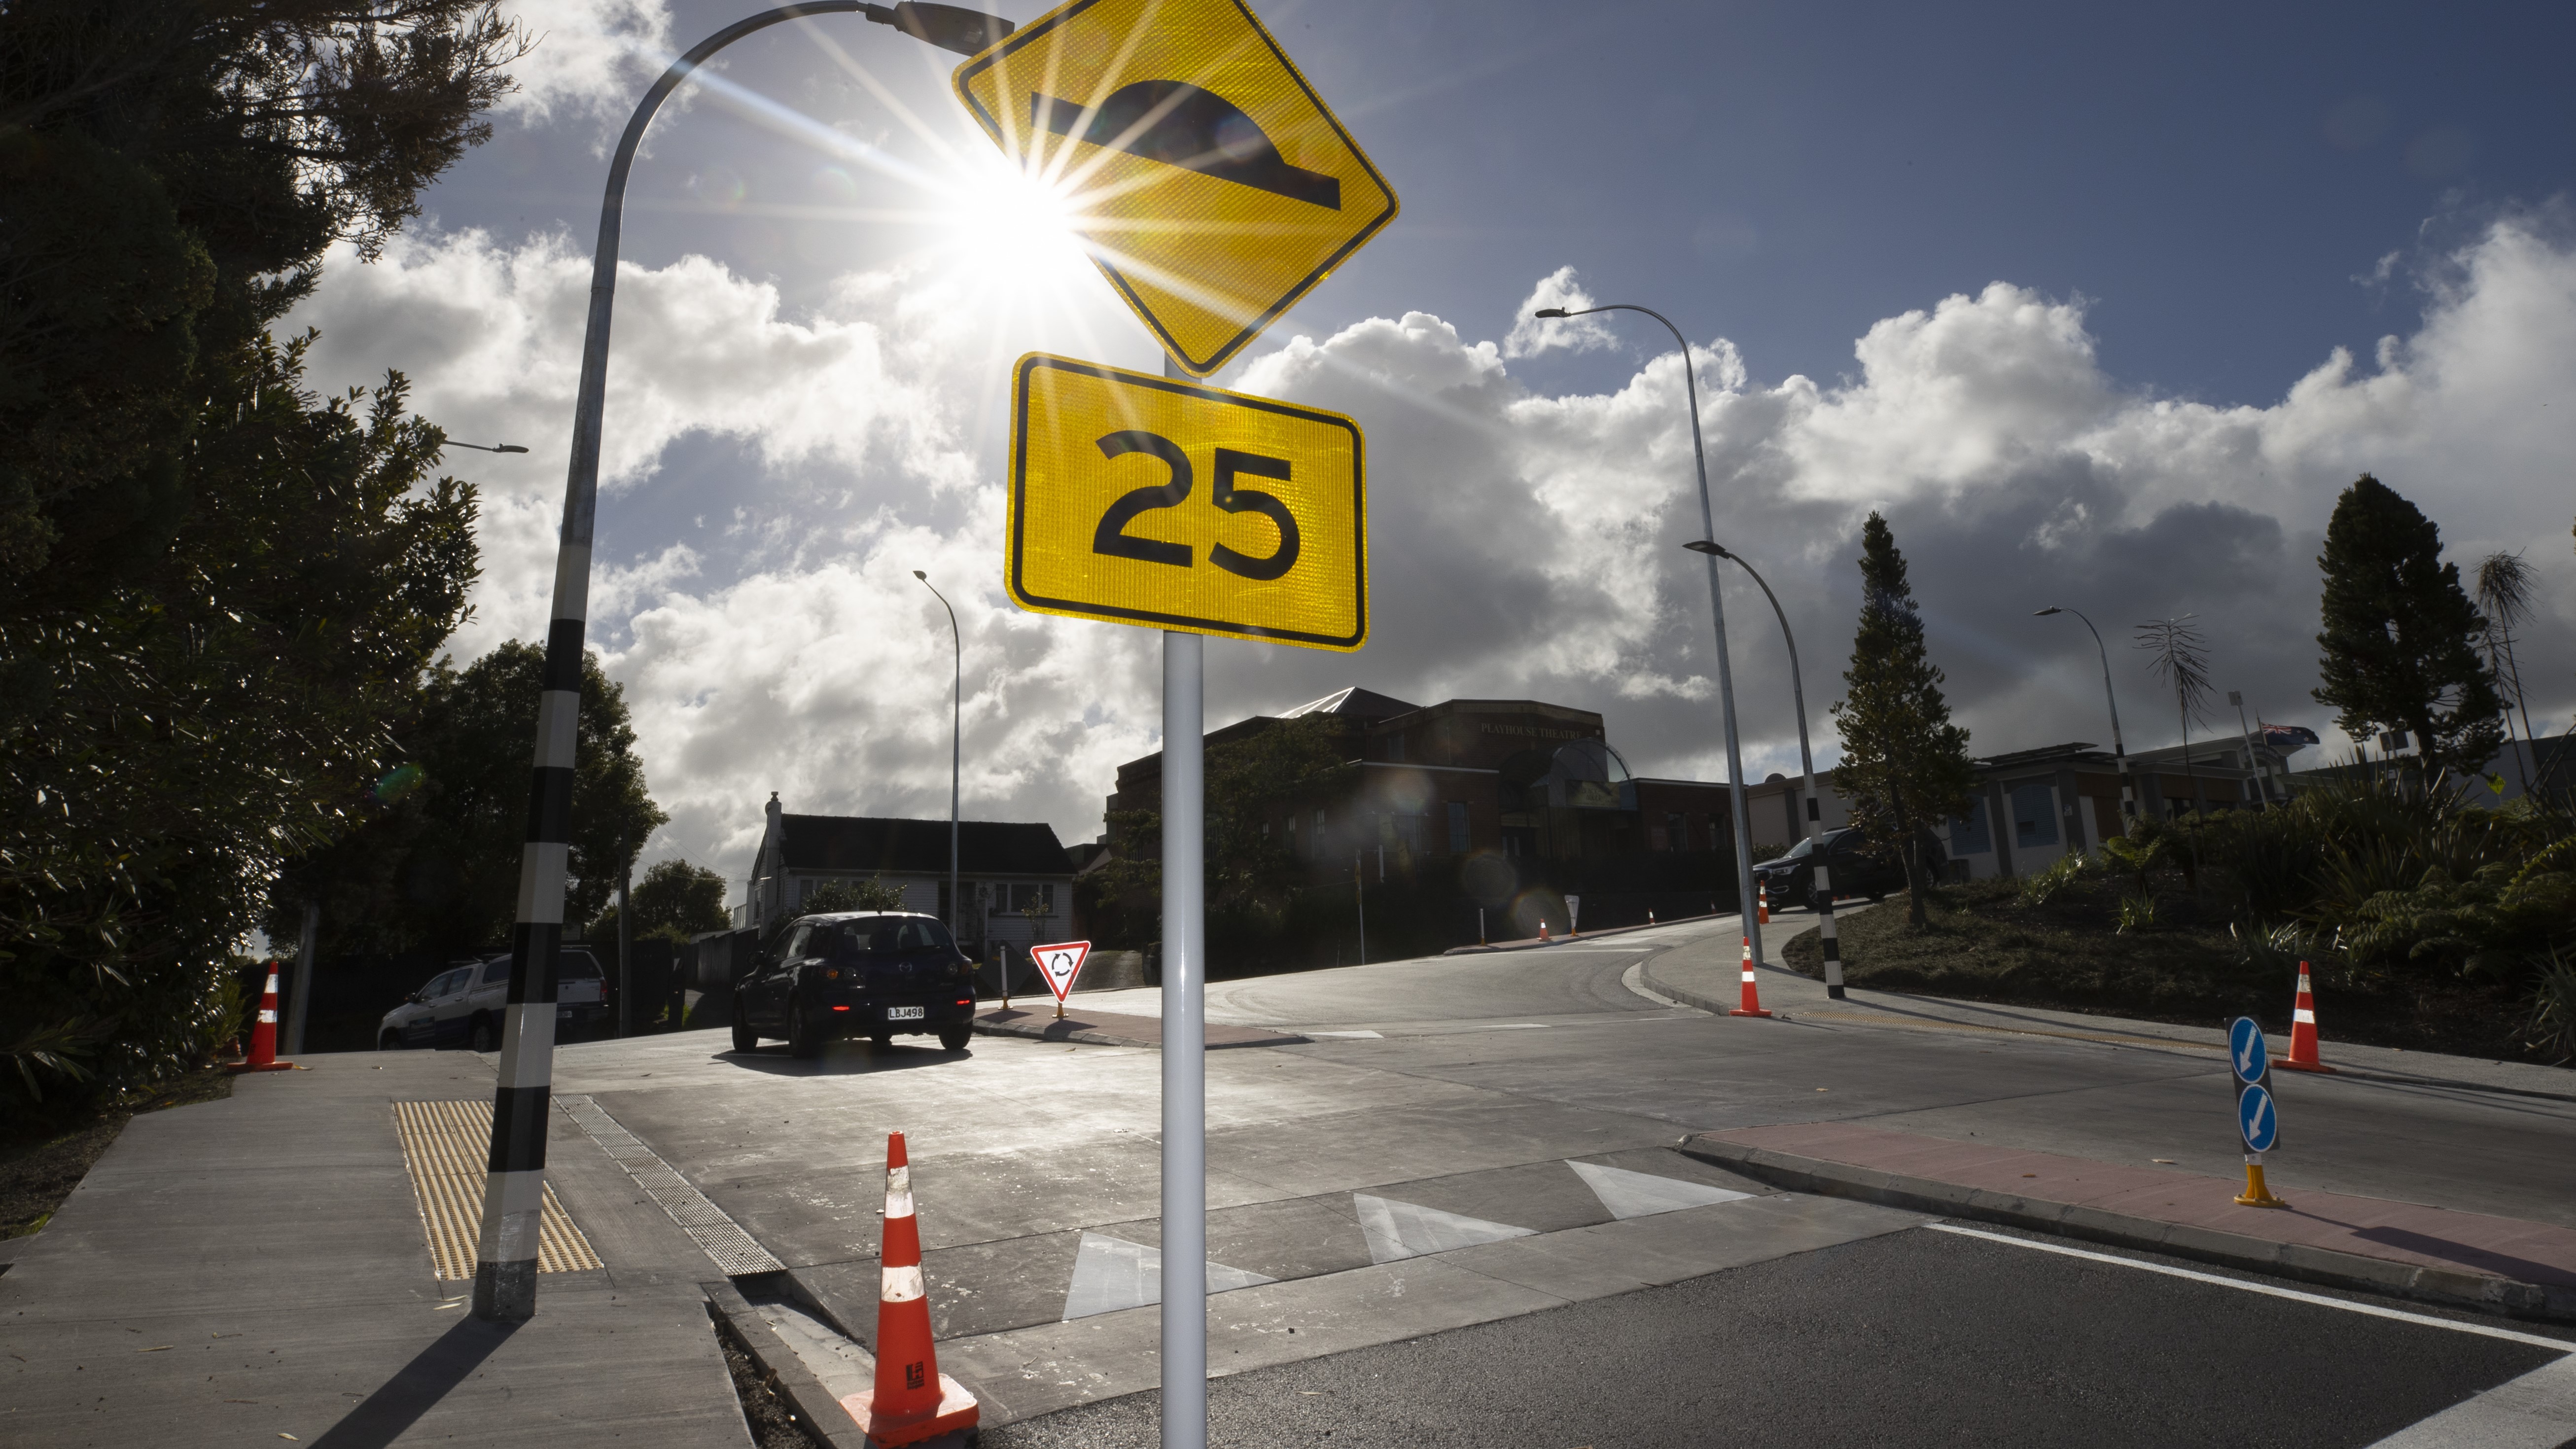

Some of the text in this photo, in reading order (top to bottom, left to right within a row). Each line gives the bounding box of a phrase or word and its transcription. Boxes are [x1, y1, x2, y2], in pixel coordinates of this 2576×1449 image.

[1093, 430, 1300, 581] 25
[1482, 723, 1582, 739] PLAYHOUSE THEATRE
[889, 1008, 923, 1018] LBJ498
